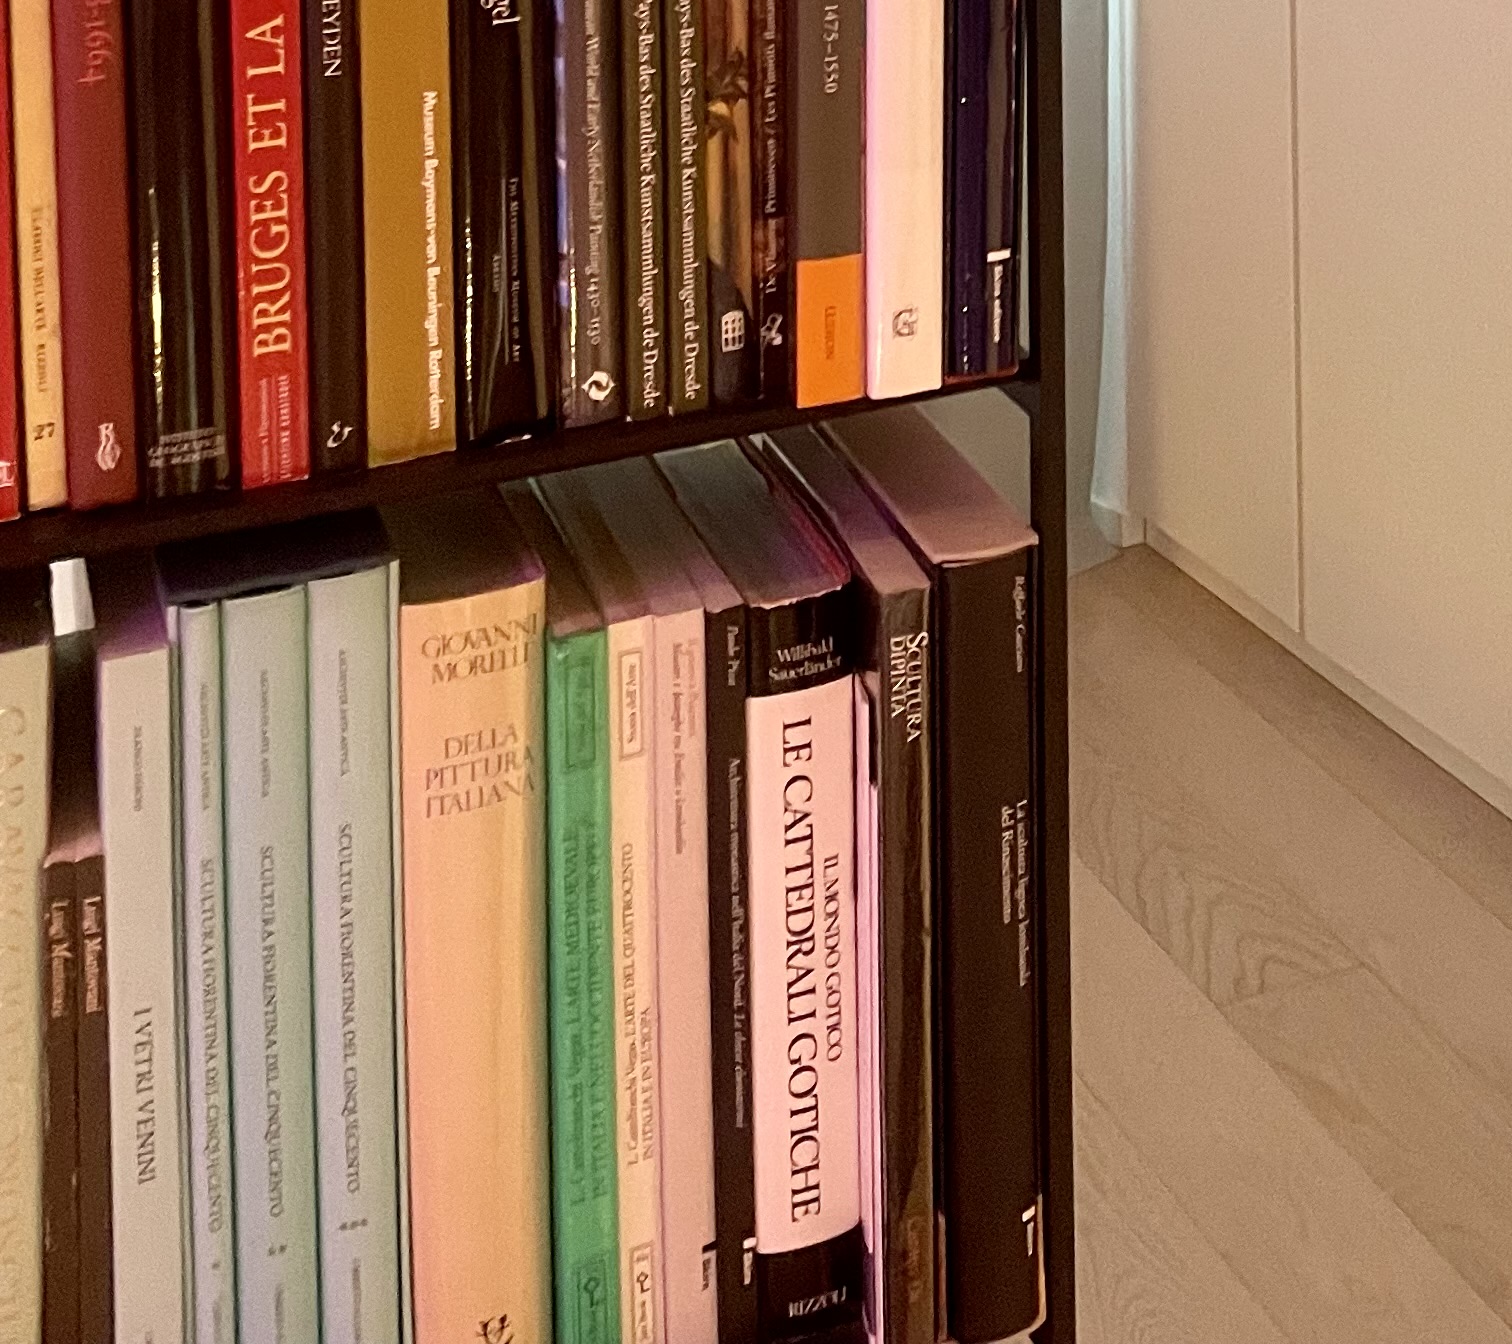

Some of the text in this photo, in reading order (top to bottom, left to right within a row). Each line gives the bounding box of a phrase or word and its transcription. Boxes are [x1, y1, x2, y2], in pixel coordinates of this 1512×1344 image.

[244, 12, 286, 79] LA
[639, 64, 656, 92] des
[679, 59, 696, 86] des
[246, 92, 287, 152] ET
[639, 93, 657, 172] Staatliche
[679, 88, 698, 165] Staatliche
[247, 169, 292, 358] BRUGES
[421, 90, 445, 430] Museum Boymans-van Beuningen Rotterdam
[637, 174, 659, 326] Kunstsammlungen
[678, 167, 699, 318] Kunstsammlungen
[641, 327, 660, 347] de
[682, 321, 700, 340] de
[641, 349, 661, 408] Dresde
[683, 342, 701, 400] Dresde
[420, 612, 538, 659] GIOVANNI
[889, 635, 908, 719] DIPINTA
[904, 630, 930, 744] SCULTURA
[425, 745, 535, 792] PITTURA
[444, 723, 519, 760] DELLA
[425, 774, 535, 819] ITALIANA
[620, 843, 637, 958] QUATTROCENTO
[1001, 806, 1015, 924] del Rinascimento
[622, 958, 636, 989] DEL
[783, 715, 821, 1223] LE CATTEDRALI GOTICHE
[823, 853, 844, 1062] IL MONDO GOTICO
[260, 845, 284, 1218] SCULTURA FIORENTINA DEL CINQUECENTO
[338, 822, 361, 1193] SCULTURA FIORENTINA DEL CINQUECENTO
[133, 1006, 157, 1186] I VETRI VENINI
[788, 1285, 848, 1318] RIZZOLI
